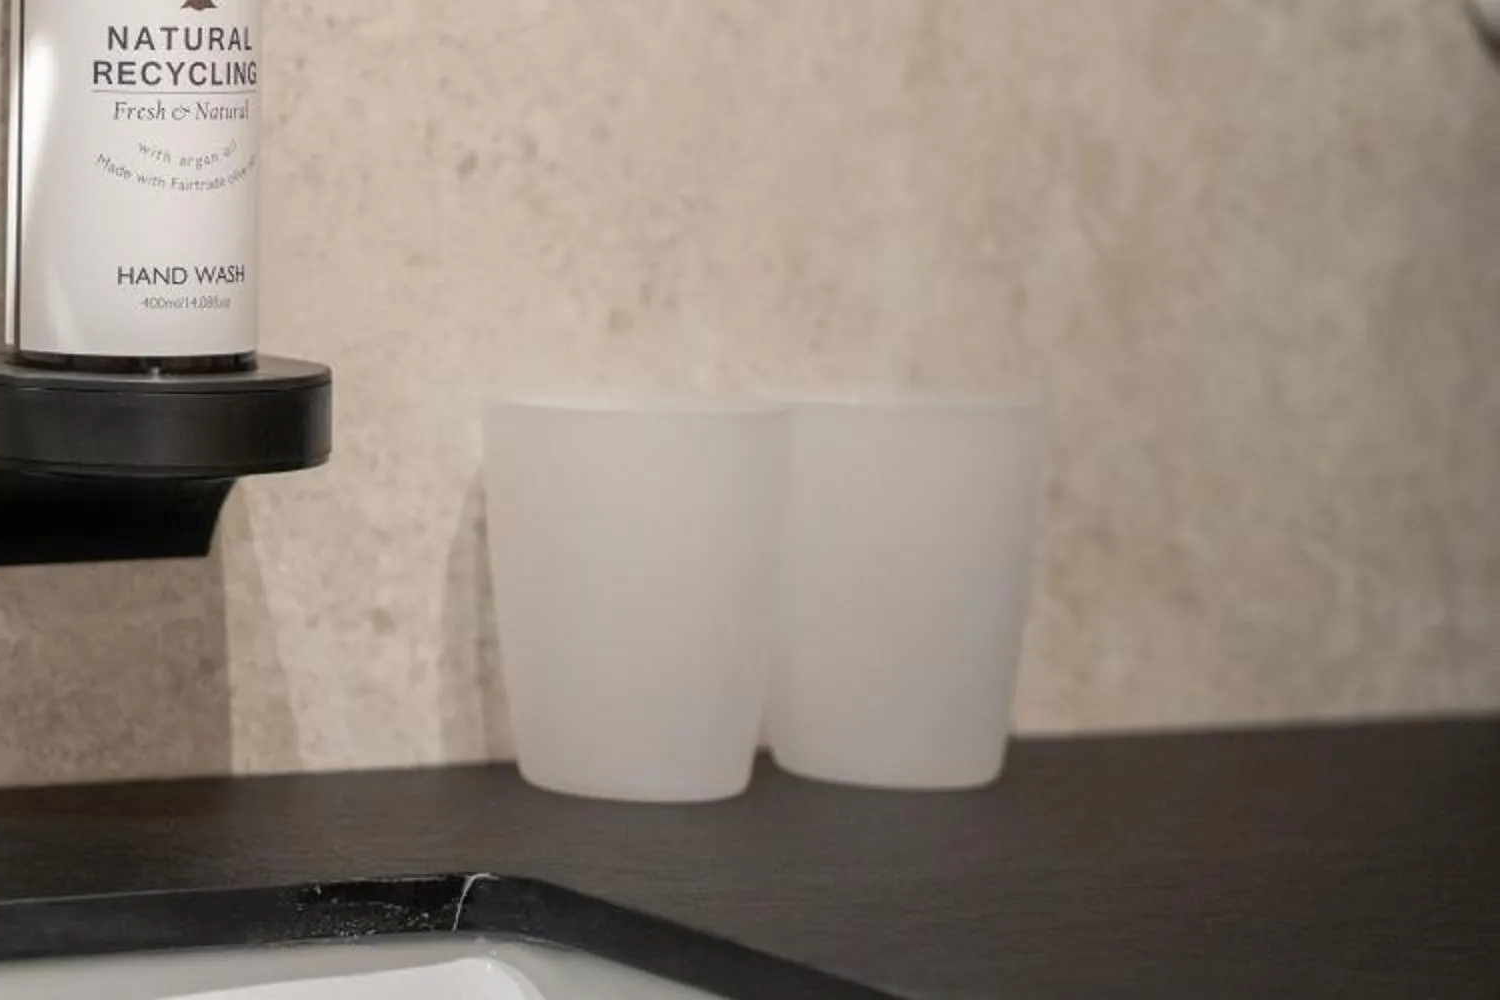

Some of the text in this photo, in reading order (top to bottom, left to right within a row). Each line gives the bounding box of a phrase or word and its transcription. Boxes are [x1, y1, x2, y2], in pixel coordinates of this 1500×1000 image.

[107, 25, 253, 51] NATURAL
[93, 60, 258, 86] RECYCLING
[113, 98, 250, 121] Fresh & Natural
[138, 142, 172, 164] with
[95, 152, 133, 180] Made
[137, 173, 167, 189] with
[117, 263, 246, 285] HAND WASH
